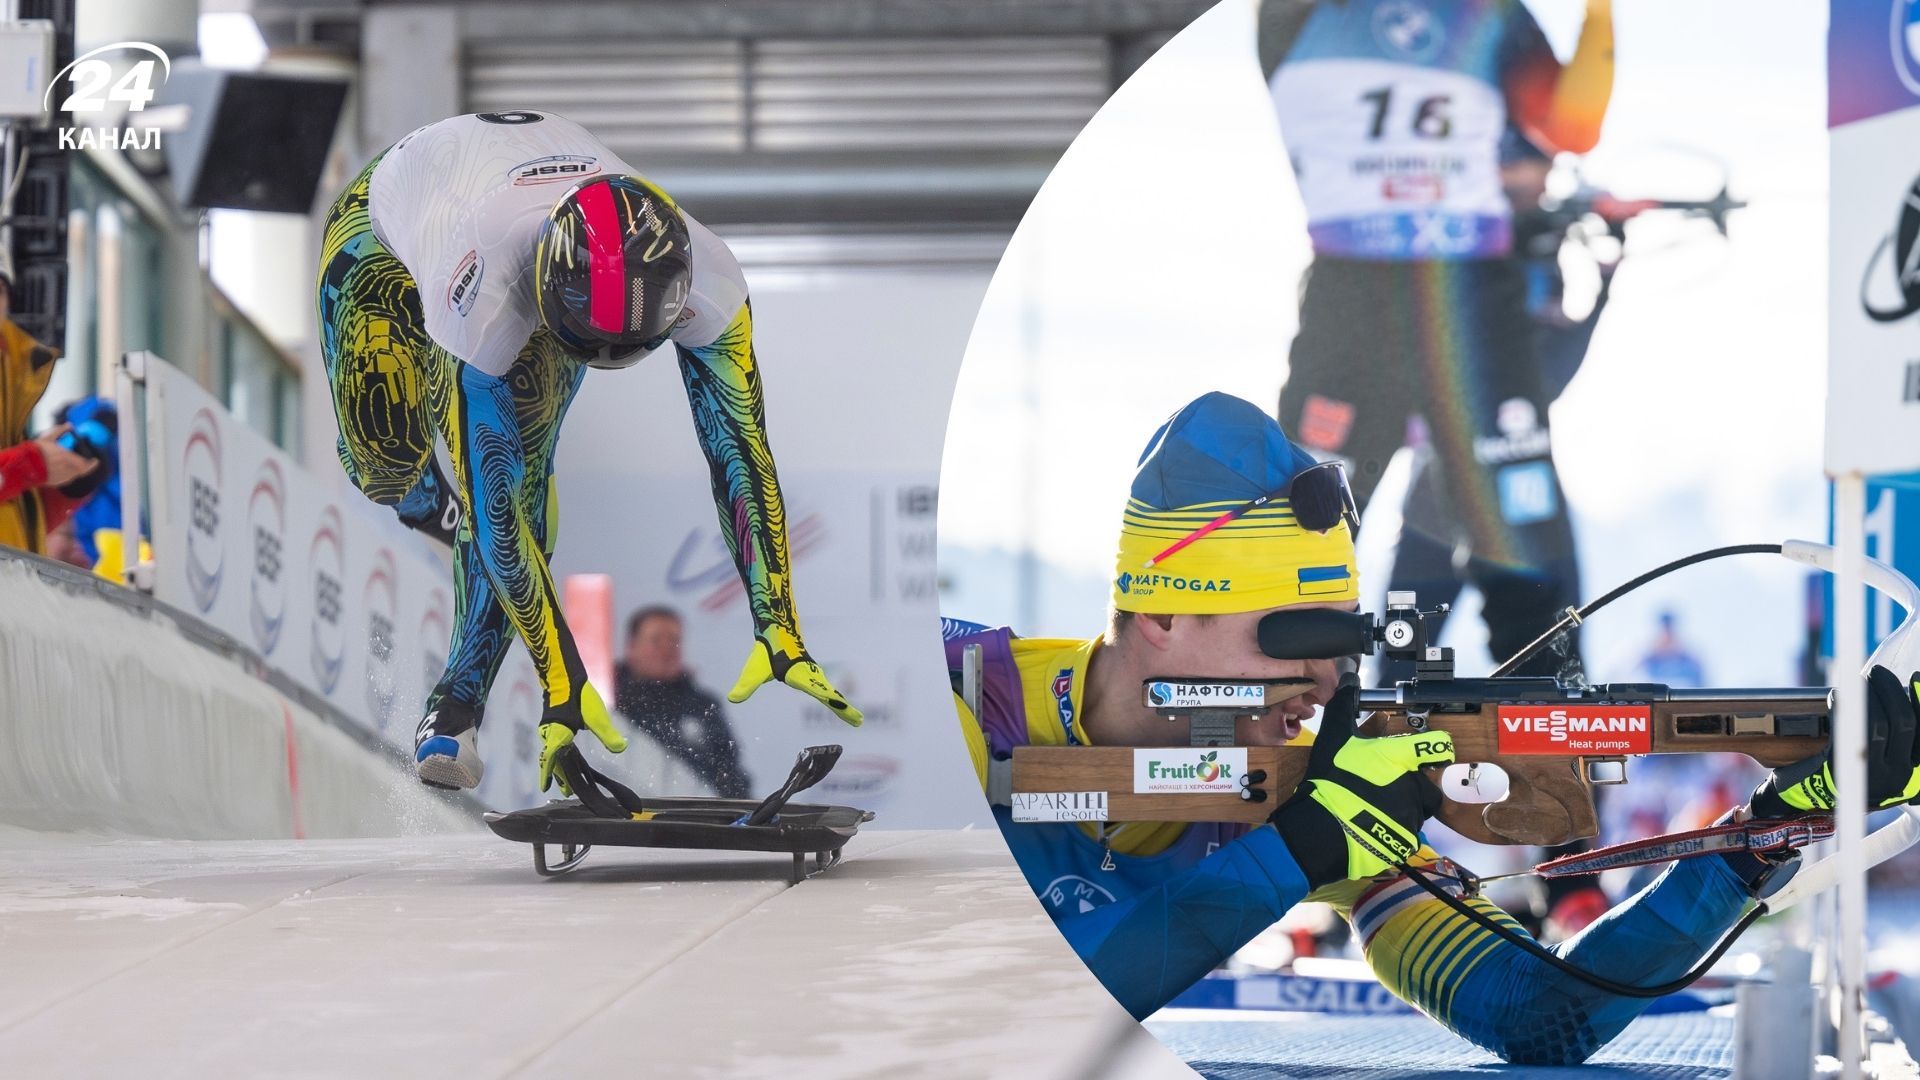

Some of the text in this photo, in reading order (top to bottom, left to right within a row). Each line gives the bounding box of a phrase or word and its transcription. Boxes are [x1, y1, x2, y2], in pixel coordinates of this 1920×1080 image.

[1361, 85, 1453, 141] 16
[521, 164, 587, 178] IBSF
[451, 262, 478, 305] IBSF
[1132, 573, 1232, 592] NAFTOGAZ
[1176, 684, 1264, 698] НАФТОГАЗ
[1502, 710, 1647, 742] VIESSMANN
[1568, 739, 1631, 751] Heat pumps
[1056, 809, 1108, 821] resorts
[1370, 822, 1412, 859] ROECK
[1050, 882, 1095, 907] BM
[1283, 979, 1398, 1013] SALO
